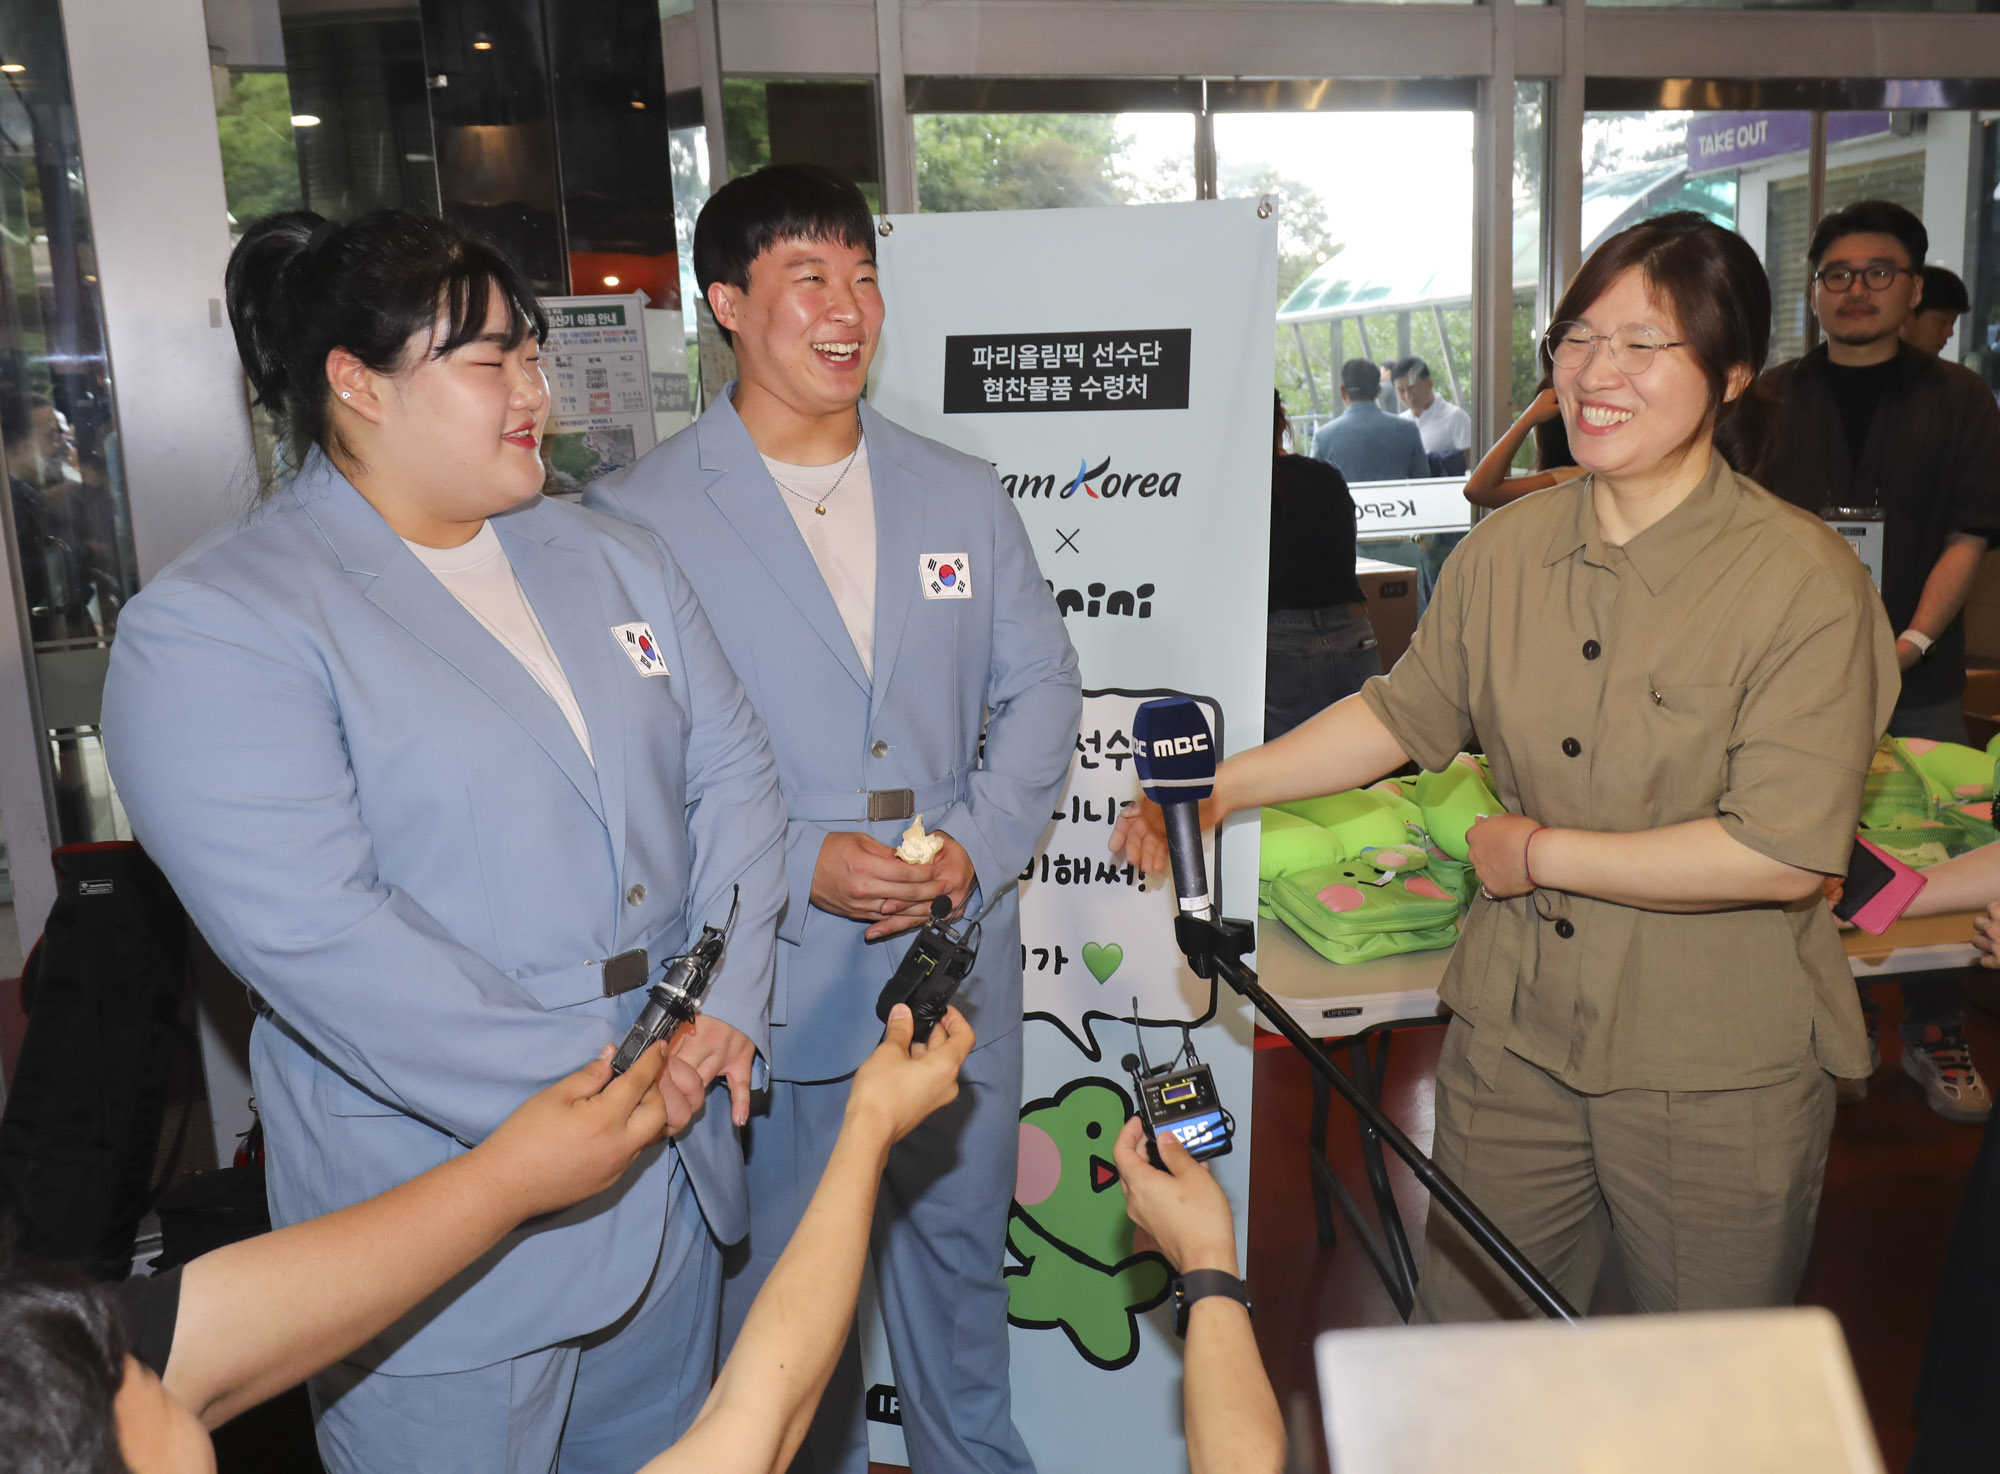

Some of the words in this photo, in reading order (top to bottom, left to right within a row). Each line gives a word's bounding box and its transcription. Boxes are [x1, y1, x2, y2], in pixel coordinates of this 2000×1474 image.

[1698, 128, 1735, 156] TAKE
[1737, 120, 1768, 148] OUT
[577, 313, 597, 326] 이용
[598, 312, 617, 325] 안내
[972, 343, 1084, 370] 파리올림픽
[1092, 341, 1162, 367] 선수단
[983, 376, 1073, 402] 협찬물품
[1079, 374, 1149, 399] 수령처
[992, 463, 1055, 499] am
[1060, 455, 1182, 499] Korea
[1153, 733, 1209, 757] MBC
[1022, 944, 1069, 975] 가
